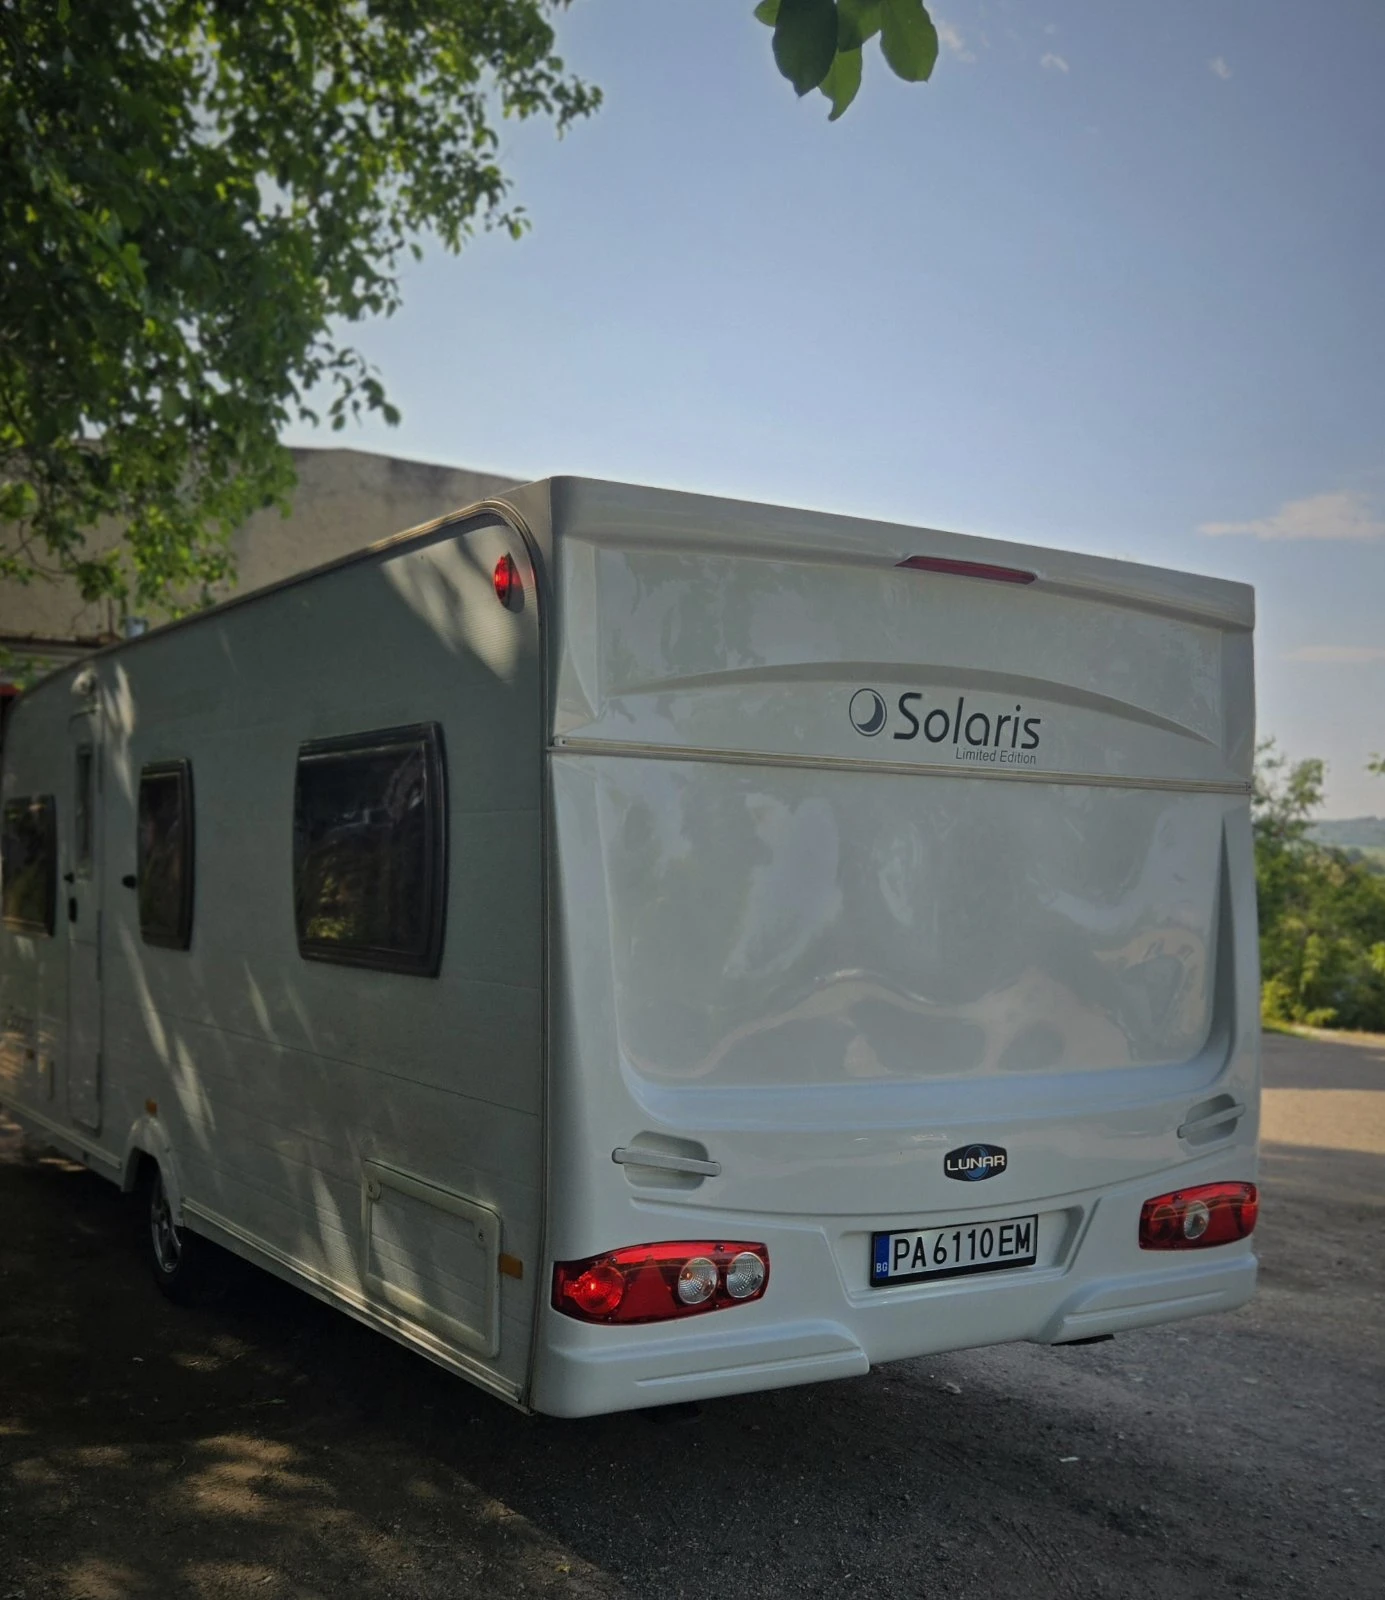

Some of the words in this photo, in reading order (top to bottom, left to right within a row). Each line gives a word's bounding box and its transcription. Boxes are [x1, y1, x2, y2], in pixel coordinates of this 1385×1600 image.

[893, 691, 1042, 750] Solaris
[955, 747, 997, 762] Limited
[1000, 750, 1037, 765] Edition
[946, 1154, 1006, 1171] LUNAR
[876, 1261, 889, 1273] BG
